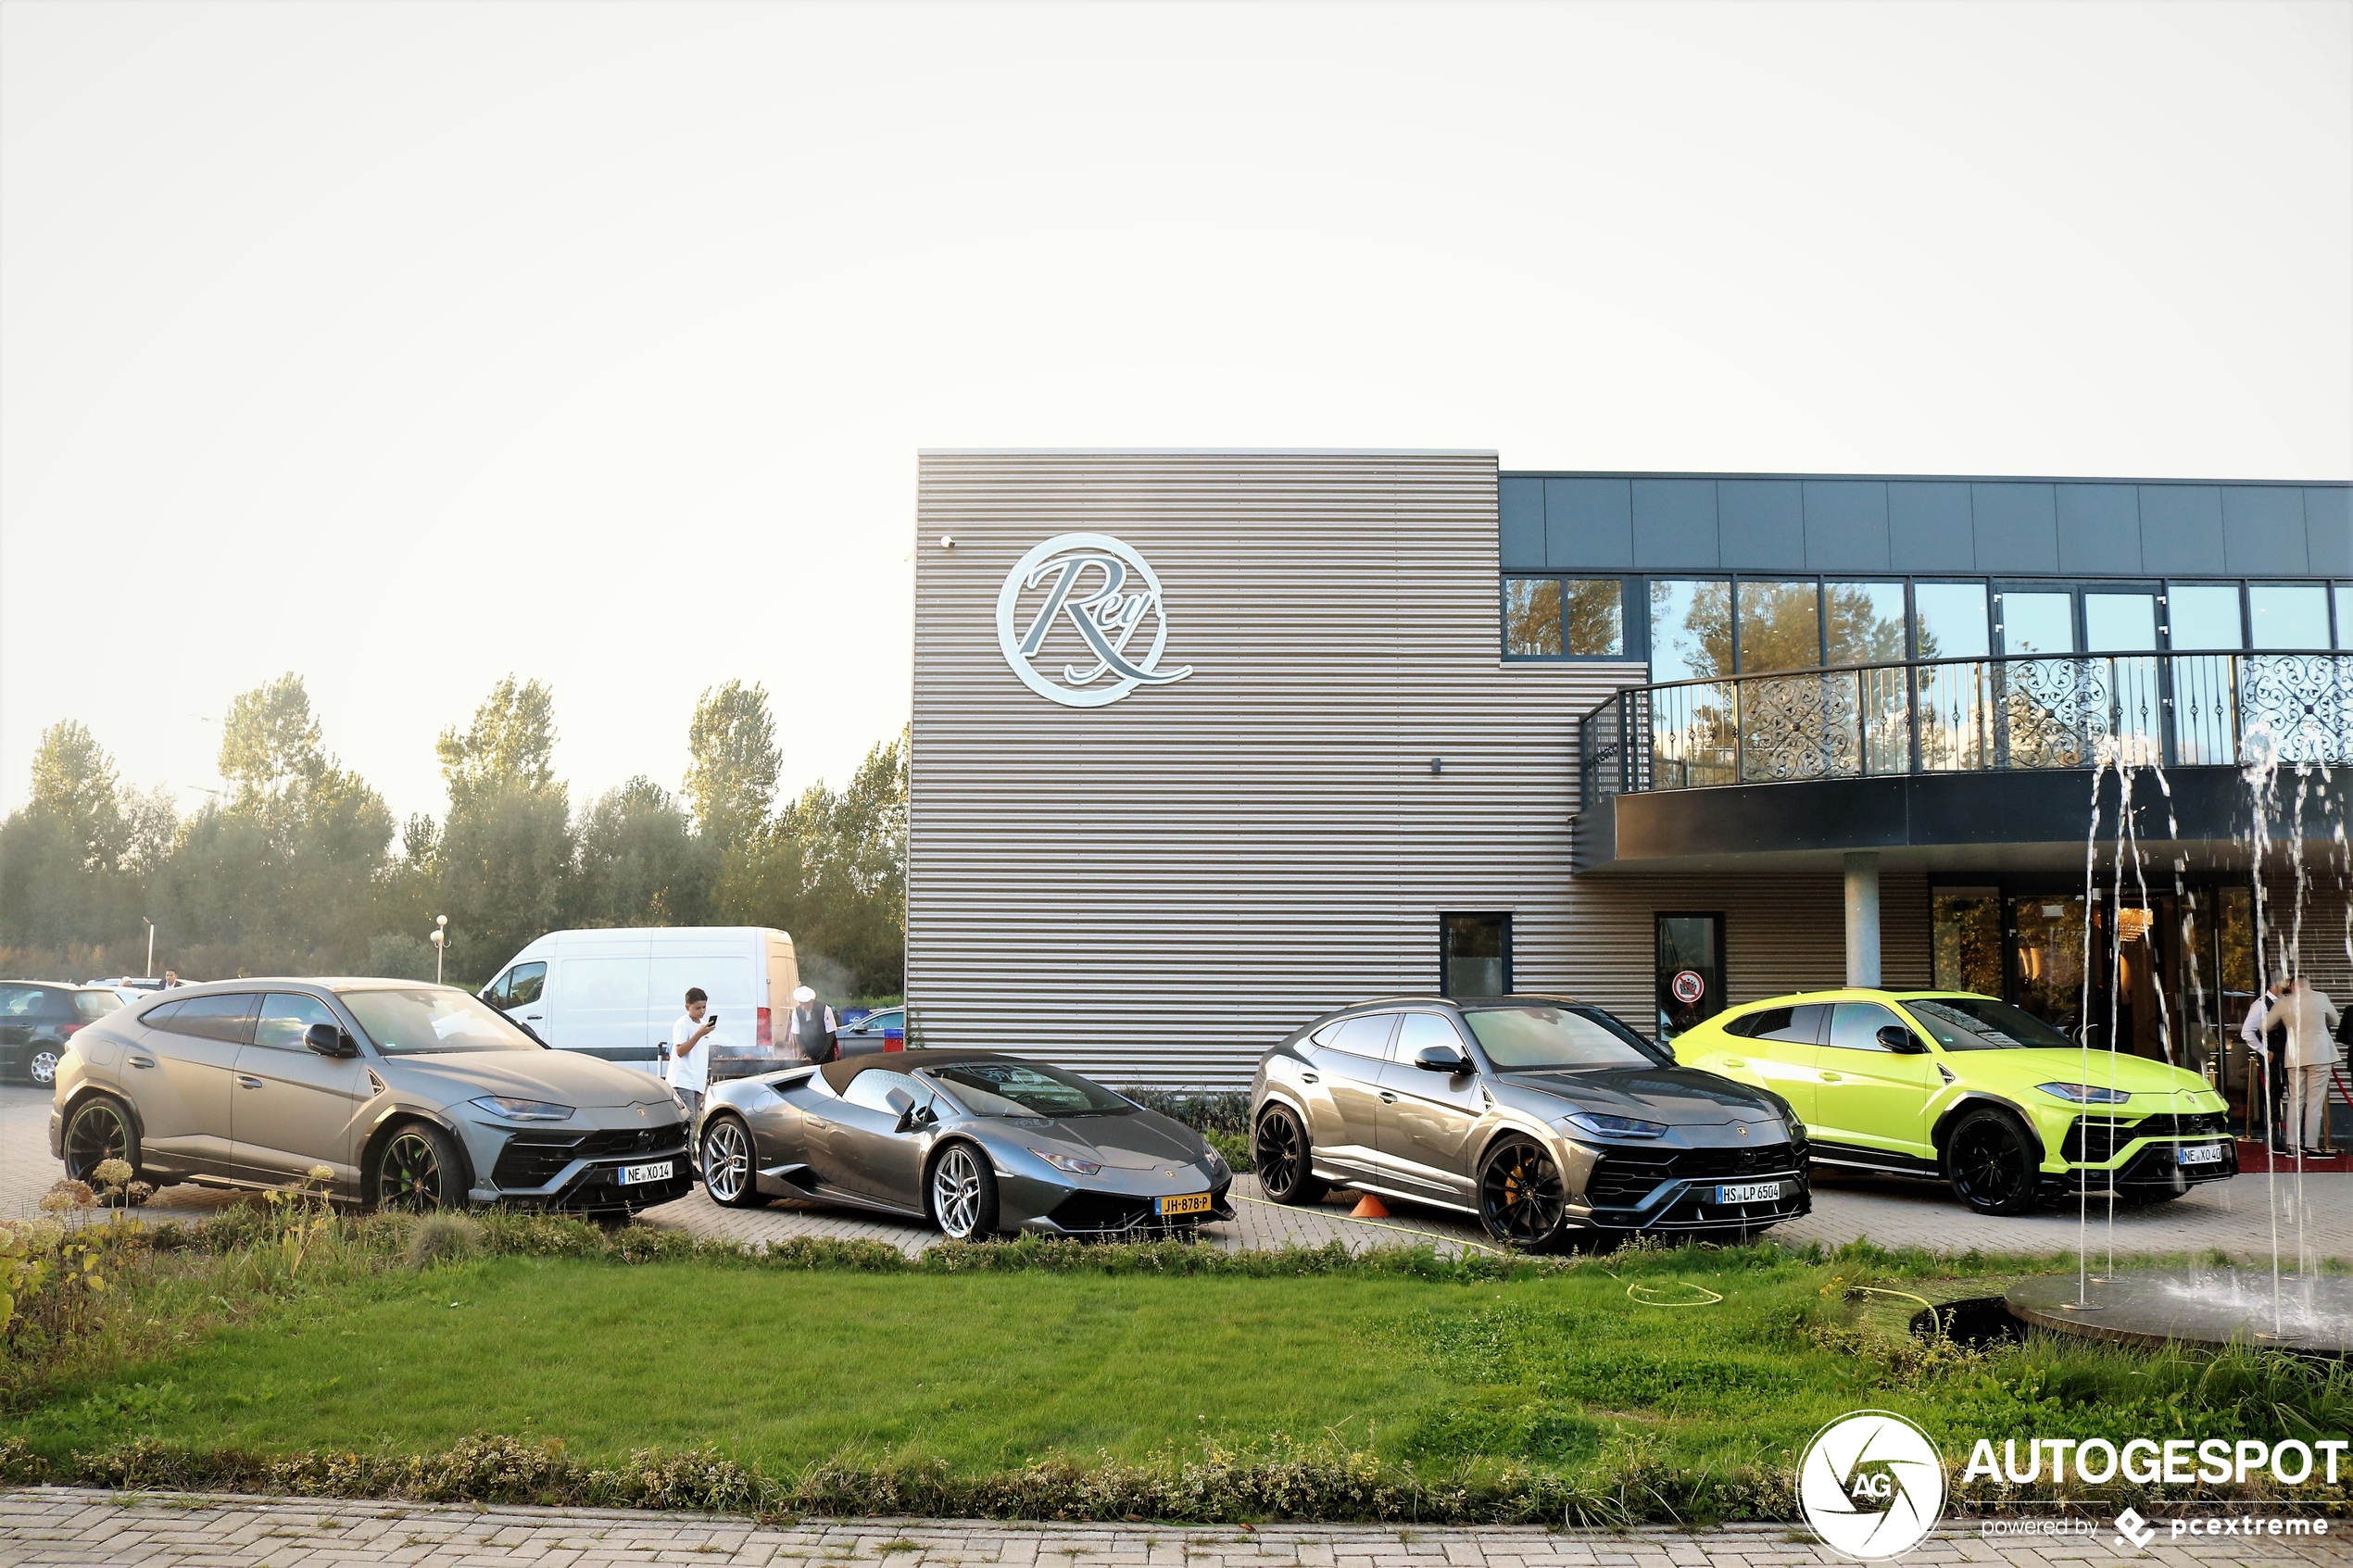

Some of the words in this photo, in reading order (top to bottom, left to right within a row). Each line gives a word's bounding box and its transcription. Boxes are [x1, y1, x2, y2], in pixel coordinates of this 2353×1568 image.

[1019, 555, 1193, 684] Rey
[2184, 1149, 2196, 1162] NE
[628, 1168, 641, 1182] NE
[1723, 1187, 1736, 1201] HS
[1743, 1186, 1755, 1200] LP
[1757, 1185, 1779, 1198] 6504
[1164, 1197, 1208, 1212] JH-878-P
